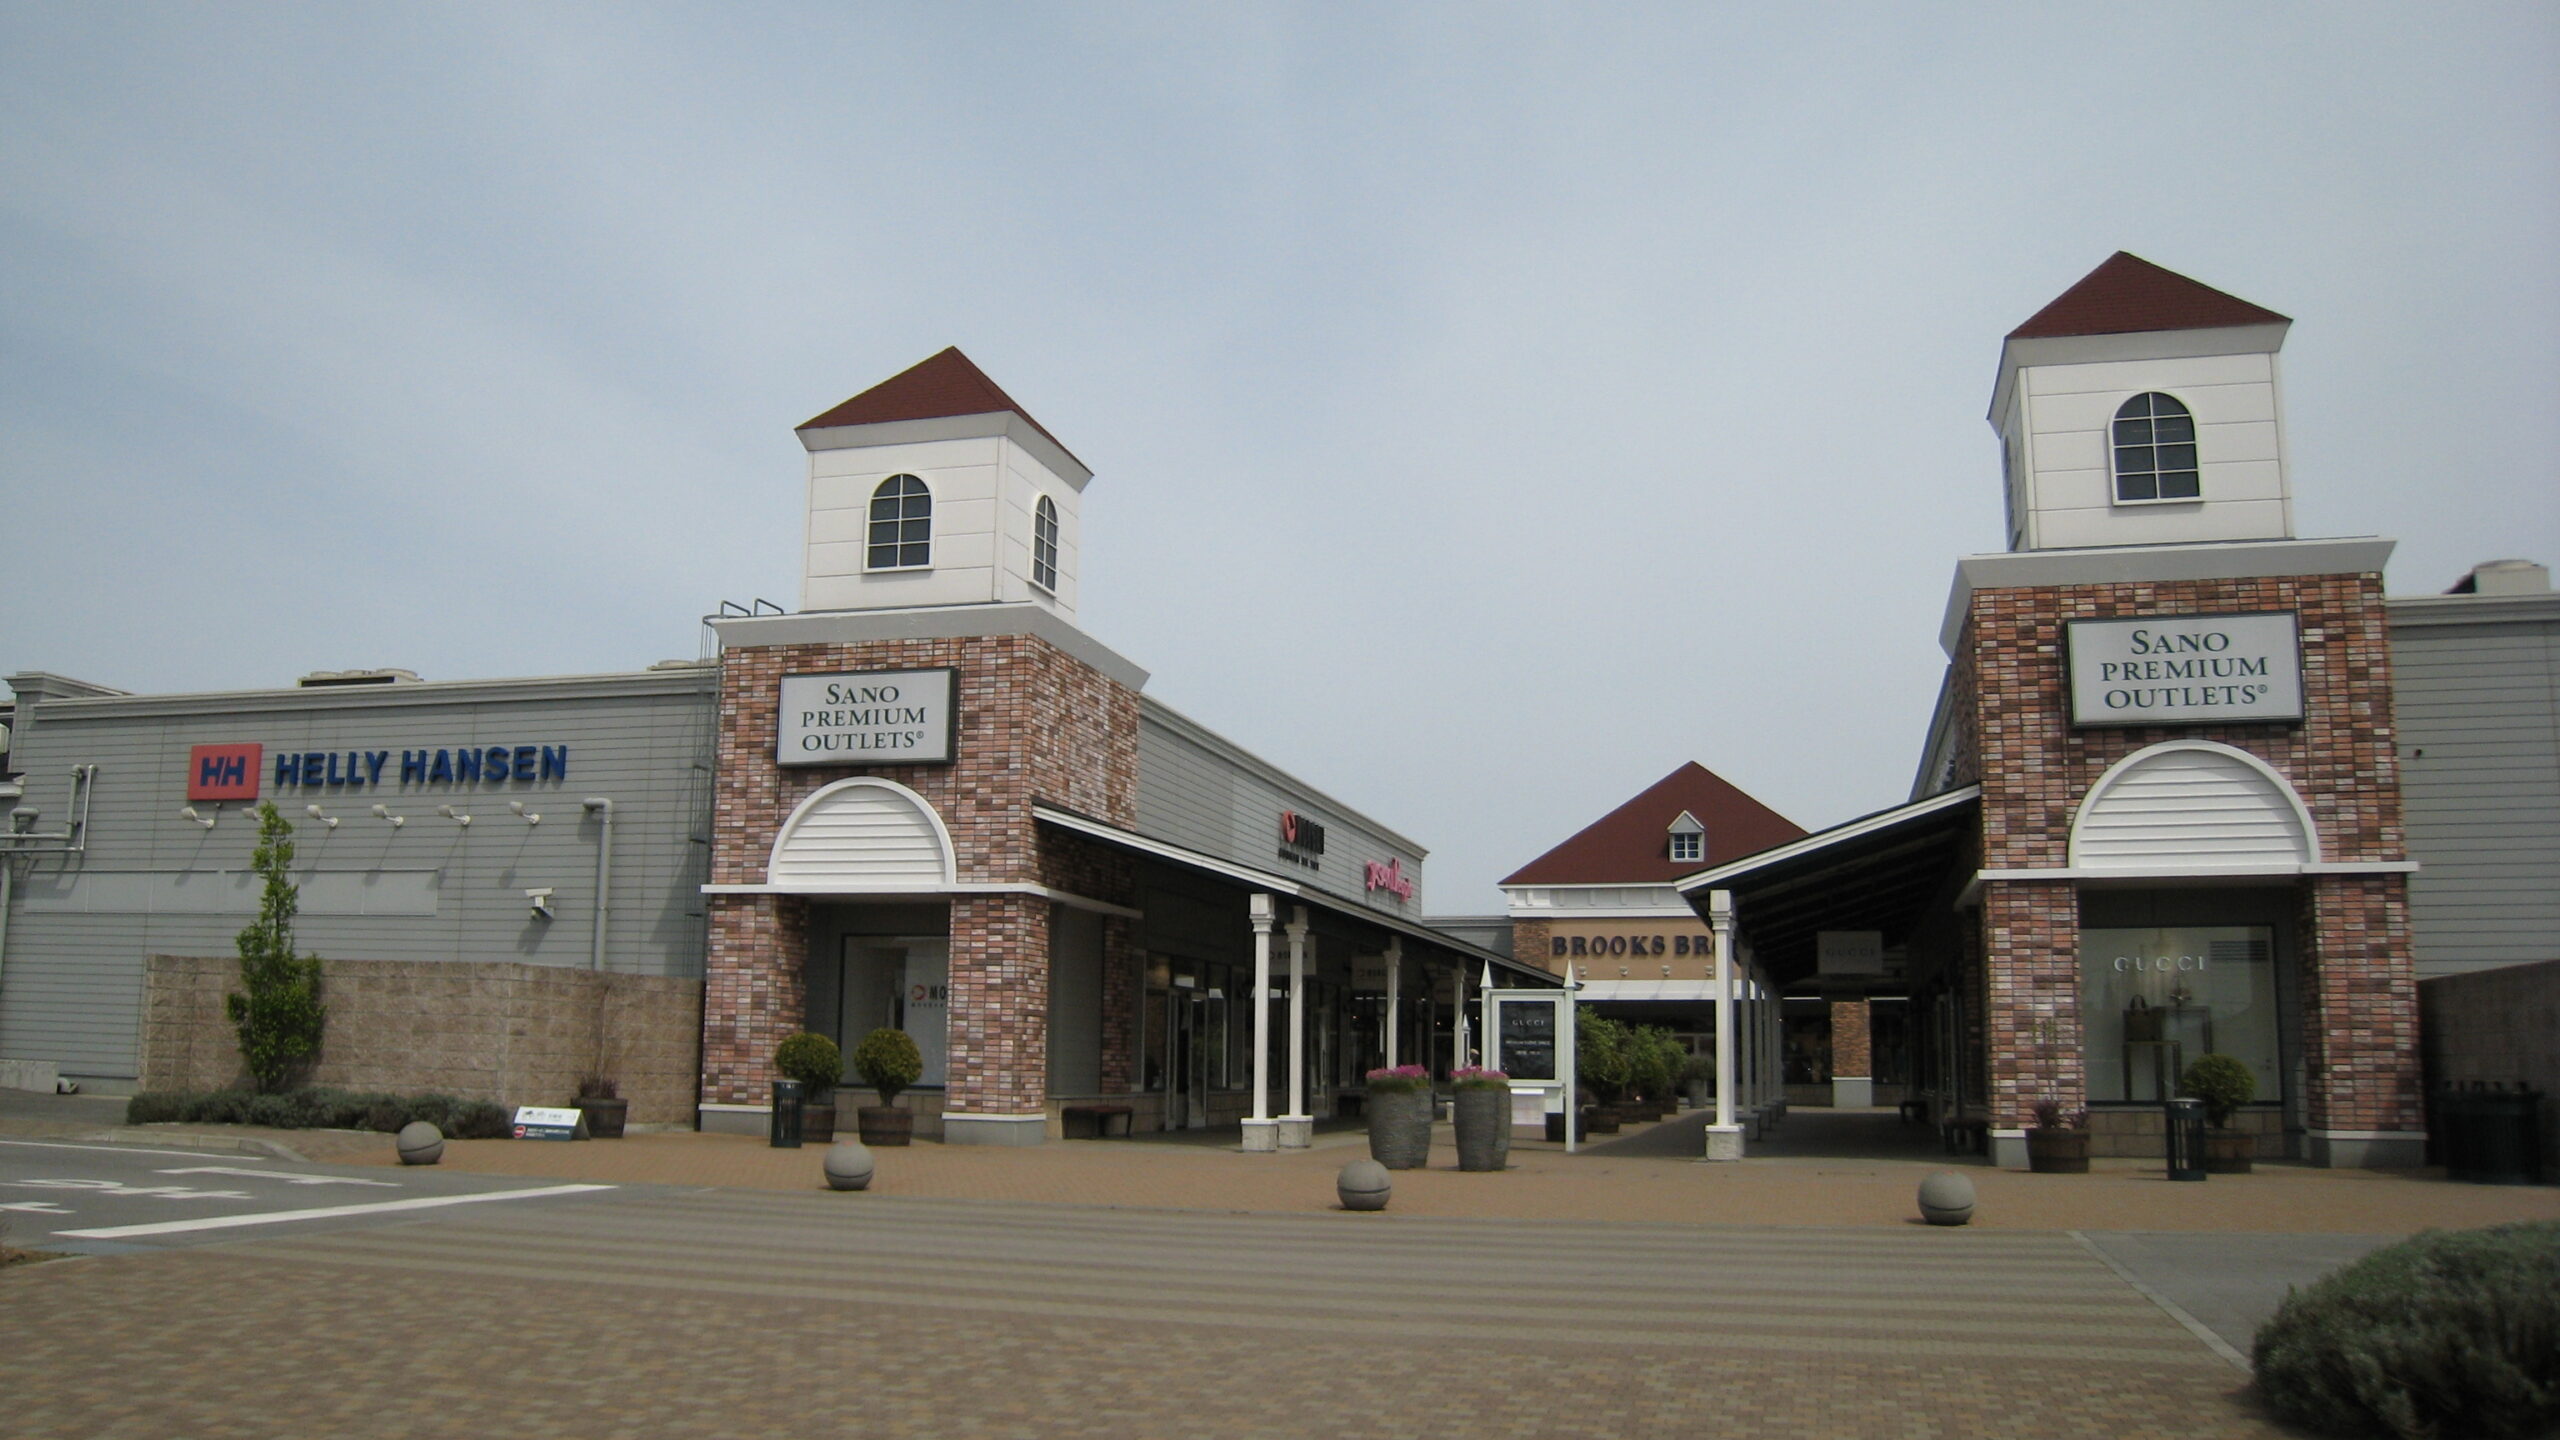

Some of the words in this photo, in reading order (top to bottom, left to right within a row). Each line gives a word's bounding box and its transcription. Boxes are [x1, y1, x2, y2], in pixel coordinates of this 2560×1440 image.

[2131, 629, 2229, 655] SANO
[2100, 656, 2268, 681] PREMIUM
[825, 683, 899, 705] SANO
[801, 706, 926, 727] PREMIUM
[275, 750, 388, 786] HELLY
[401, 744, 568, 784] HANSEN
[1551, 935, 1665, 956] BROOKS
[2113, 955, 2205, 972] GUCCI
